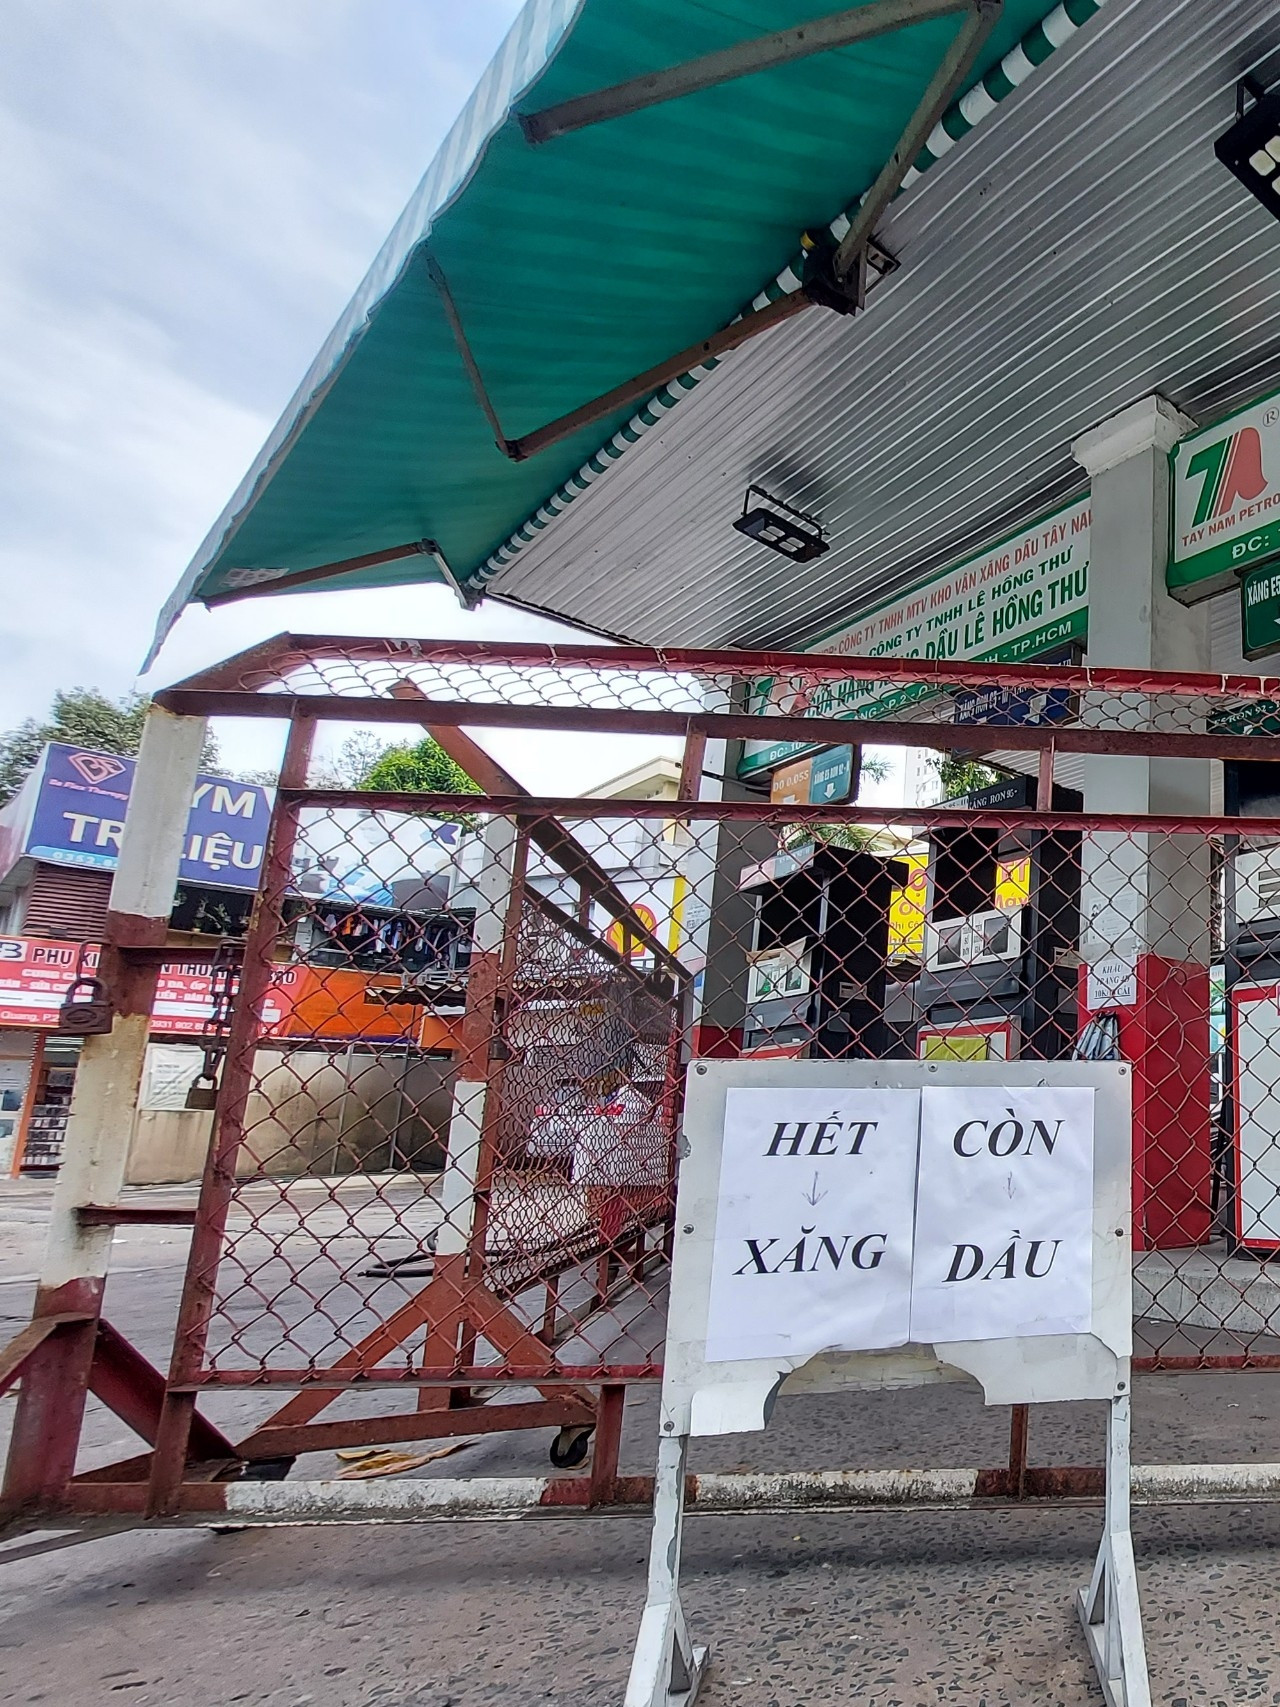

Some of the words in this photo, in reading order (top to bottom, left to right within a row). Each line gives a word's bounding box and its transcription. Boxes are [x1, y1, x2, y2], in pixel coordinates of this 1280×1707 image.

[1181, 528, 1205, 547] TAY
[1208, 513, 1236, 536] NAM
[1231, 534, 1270, 560] ĐC:
[836, 626, 863, 656] CÔNG
[865, 621, 876, 641] TY
[879, 609, 903, 631] TNHH
[907, 597, 928, 621] MTV
[931, 585, 951, 609] KHO
[955, 571, 976, 596] VẬN
[980, 557, 1010, 583] XĂNG
[1014, 538, 1039, 564] DẦU
[1042, 523, 1067, 549] TÂY
[869, 635, 902, 656] CÔNG
[906, 625, 922, 641] TY
[926, 604, 963, 631] TNHH
[968, 590, 985, 612] LÊ
[991, 569, 1034, 600] HỒNG
[1039, 545, 1073, 576] THƯ
[926, 628, 958, 659] DẦU
[964, 612, 985, 650] LÊ
[992, 589, 1043, 637] HỒNG
[1047, 561, 1090, 610] THƯ
[1247, 580, 1269, 606] XĂNG
[1011, 621, 1072, 656] TP.HCM
[191, 783, 257, 819] YM
[33, 948, 73, 968] PHỤ
[762, 1111, 878, 1157] HẾT
[952, 1108, 1065, 1158] CÒN
[732, 1224, 888, 1276] XĂNG
[942, 1229, 1064, 1283] DẦU
